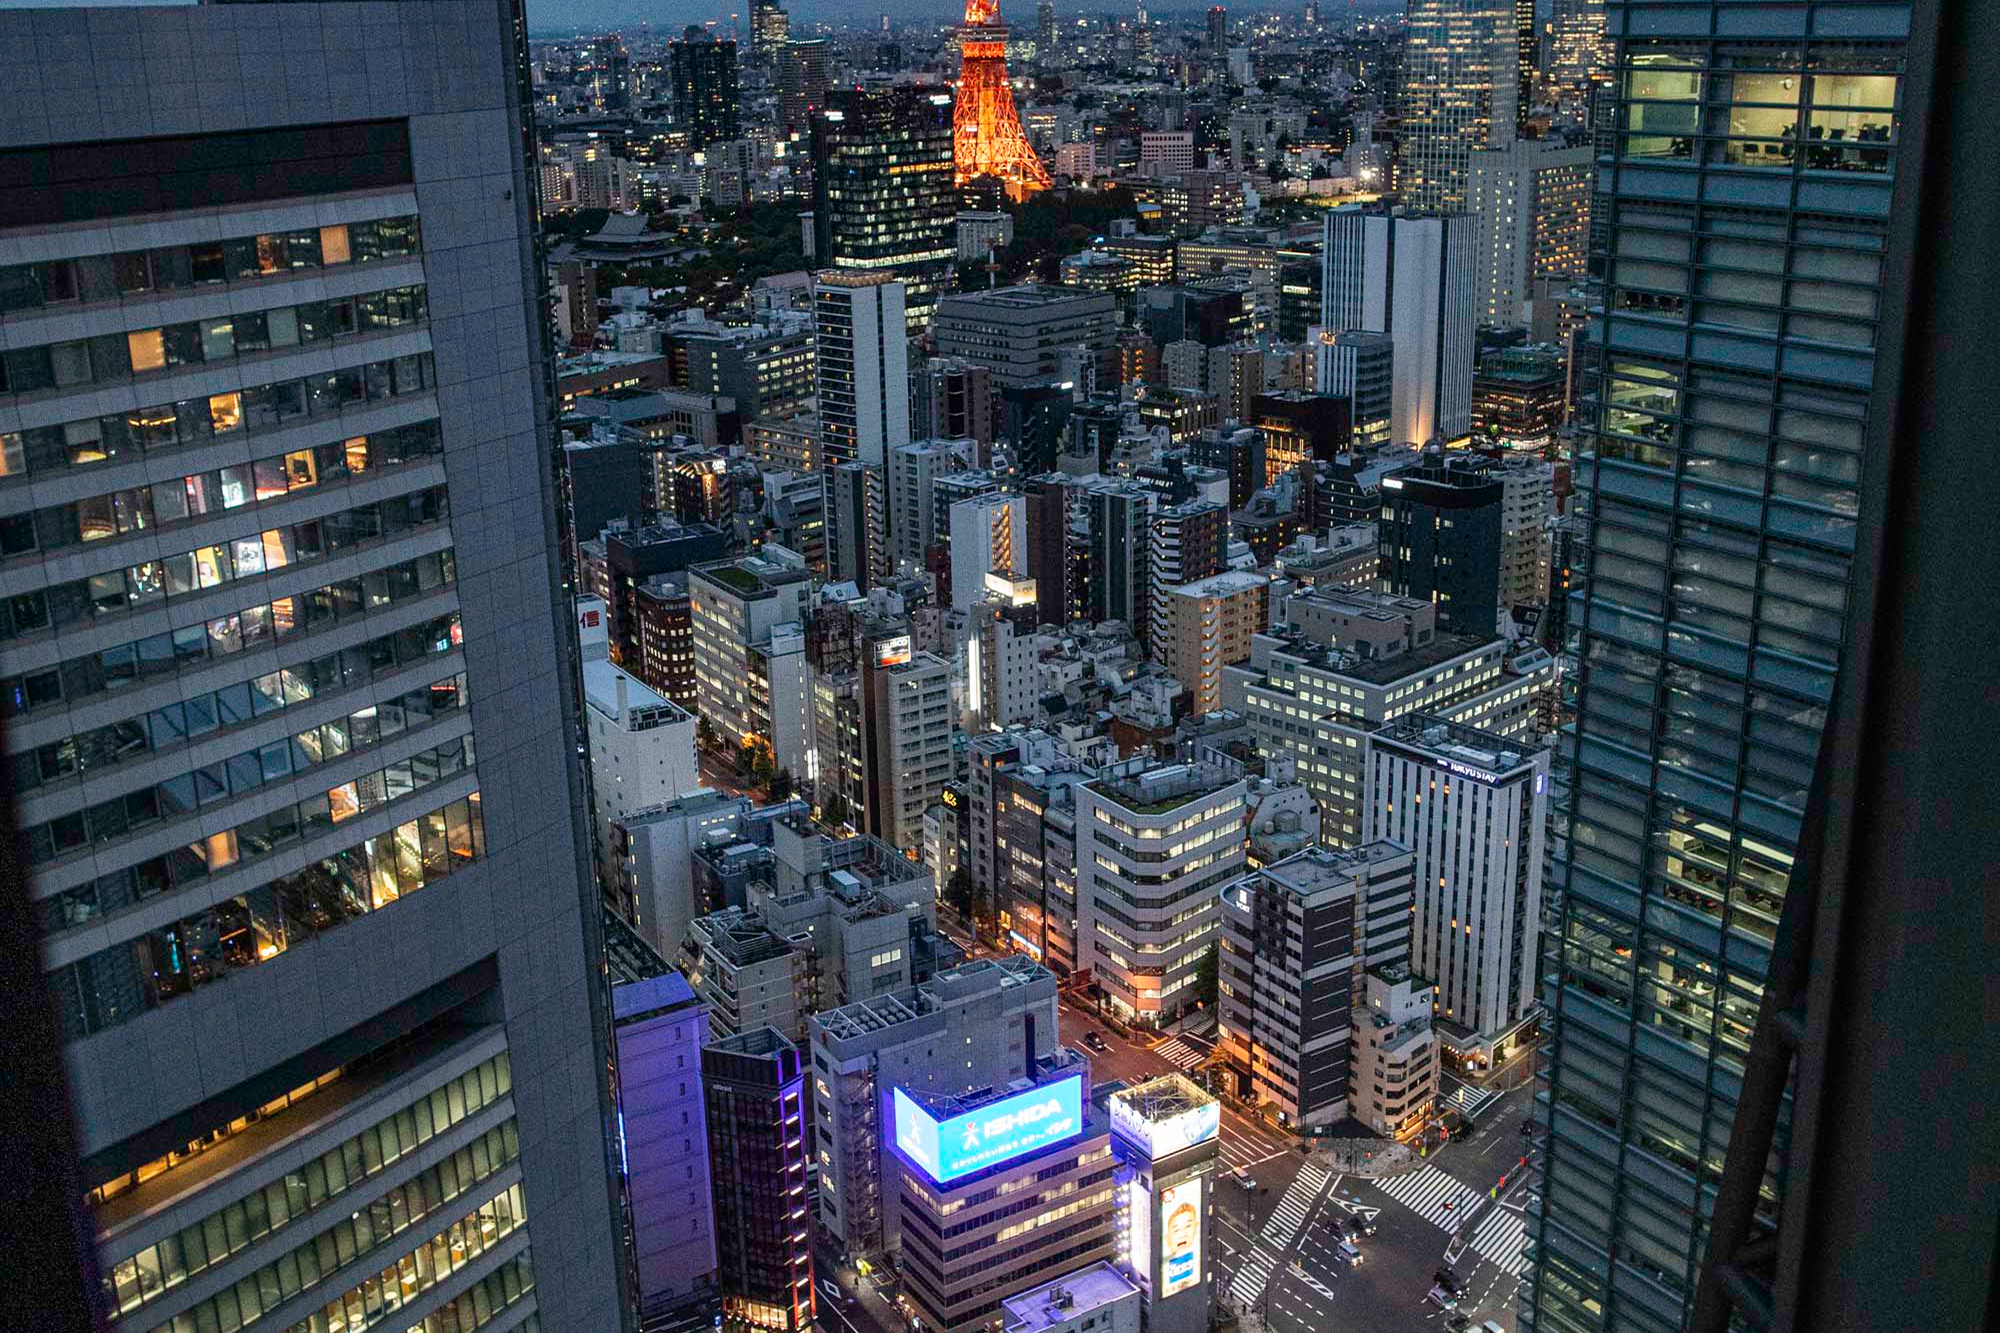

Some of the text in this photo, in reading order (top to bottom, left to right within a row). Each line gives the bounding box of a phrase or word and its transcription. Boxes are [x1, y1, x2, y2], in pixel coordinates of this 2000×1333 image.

[580, 610, 600, 629] 信
[1450, 763, 1496, 783] TOKYU STAY
[984, 1098, 1062, 1138] ISHIDA
